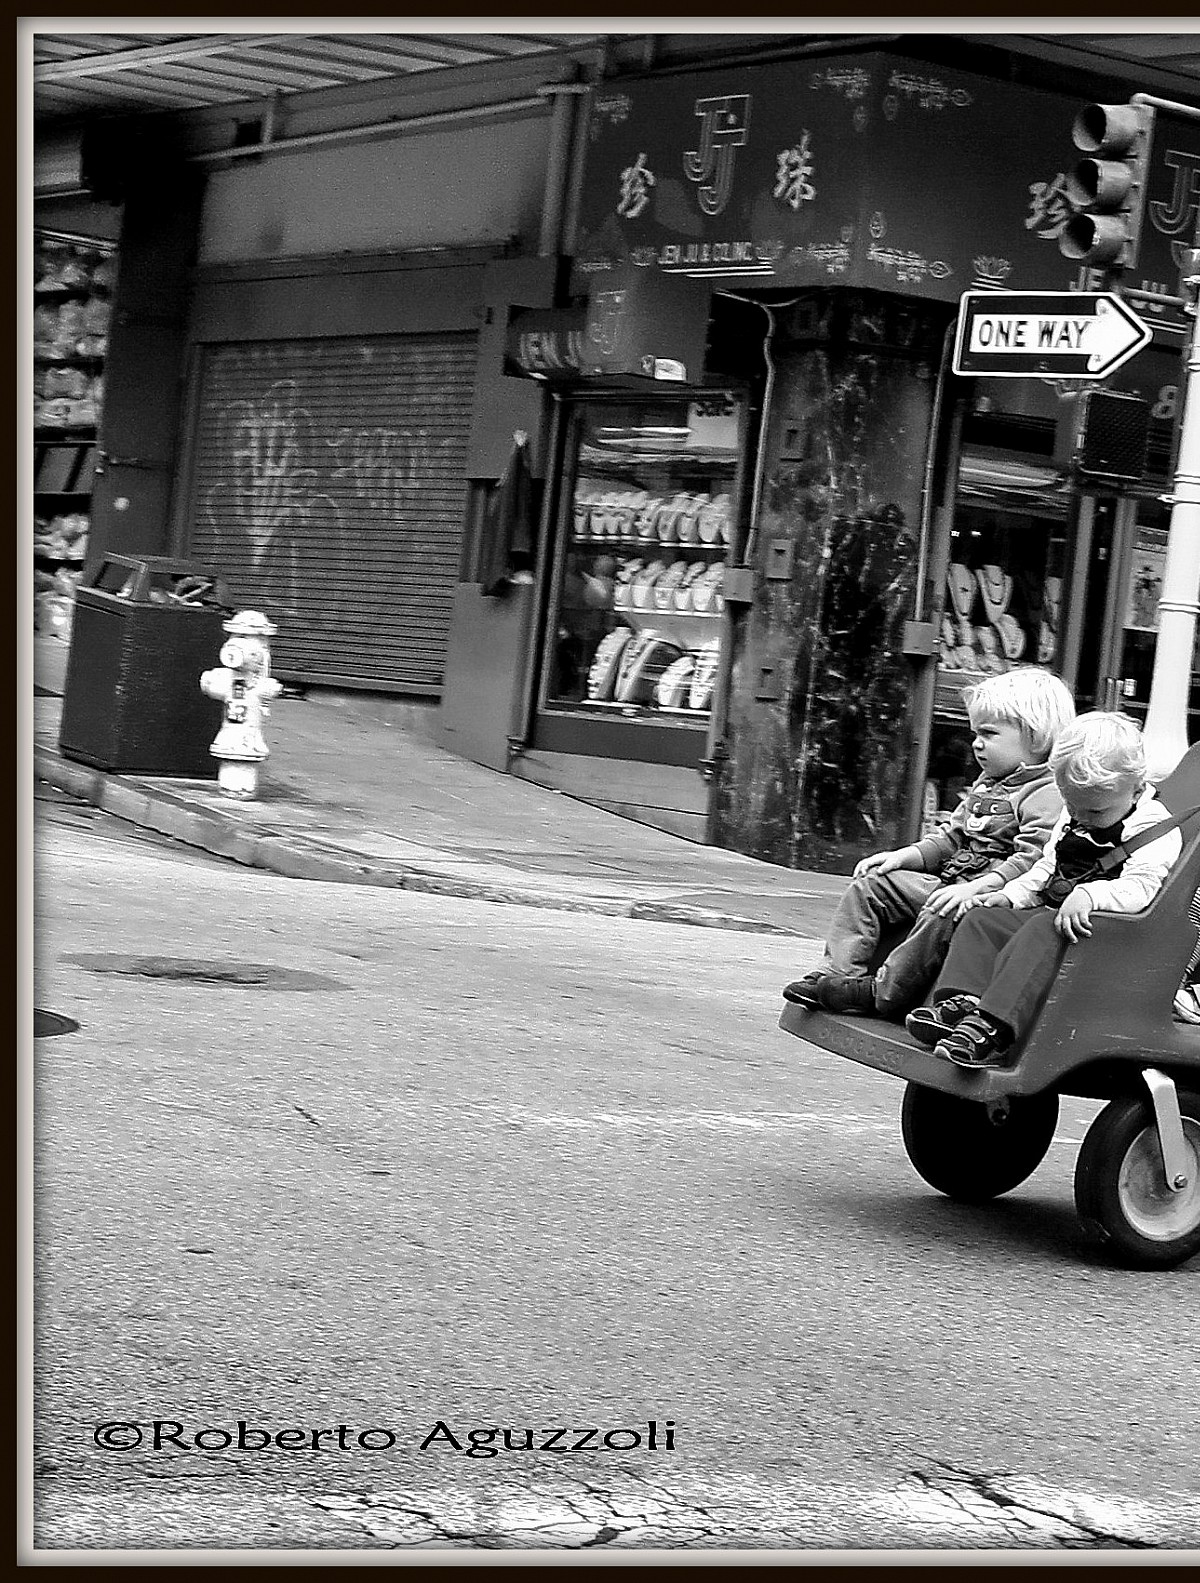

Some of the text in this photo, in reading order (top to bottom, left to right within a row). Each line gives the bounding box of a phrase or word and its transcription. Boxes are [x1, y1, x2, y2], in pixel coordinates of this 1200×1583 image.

[617, 127, 817, 218] 珍 珠
[978, 319, 1093, 349] ONE WAY
